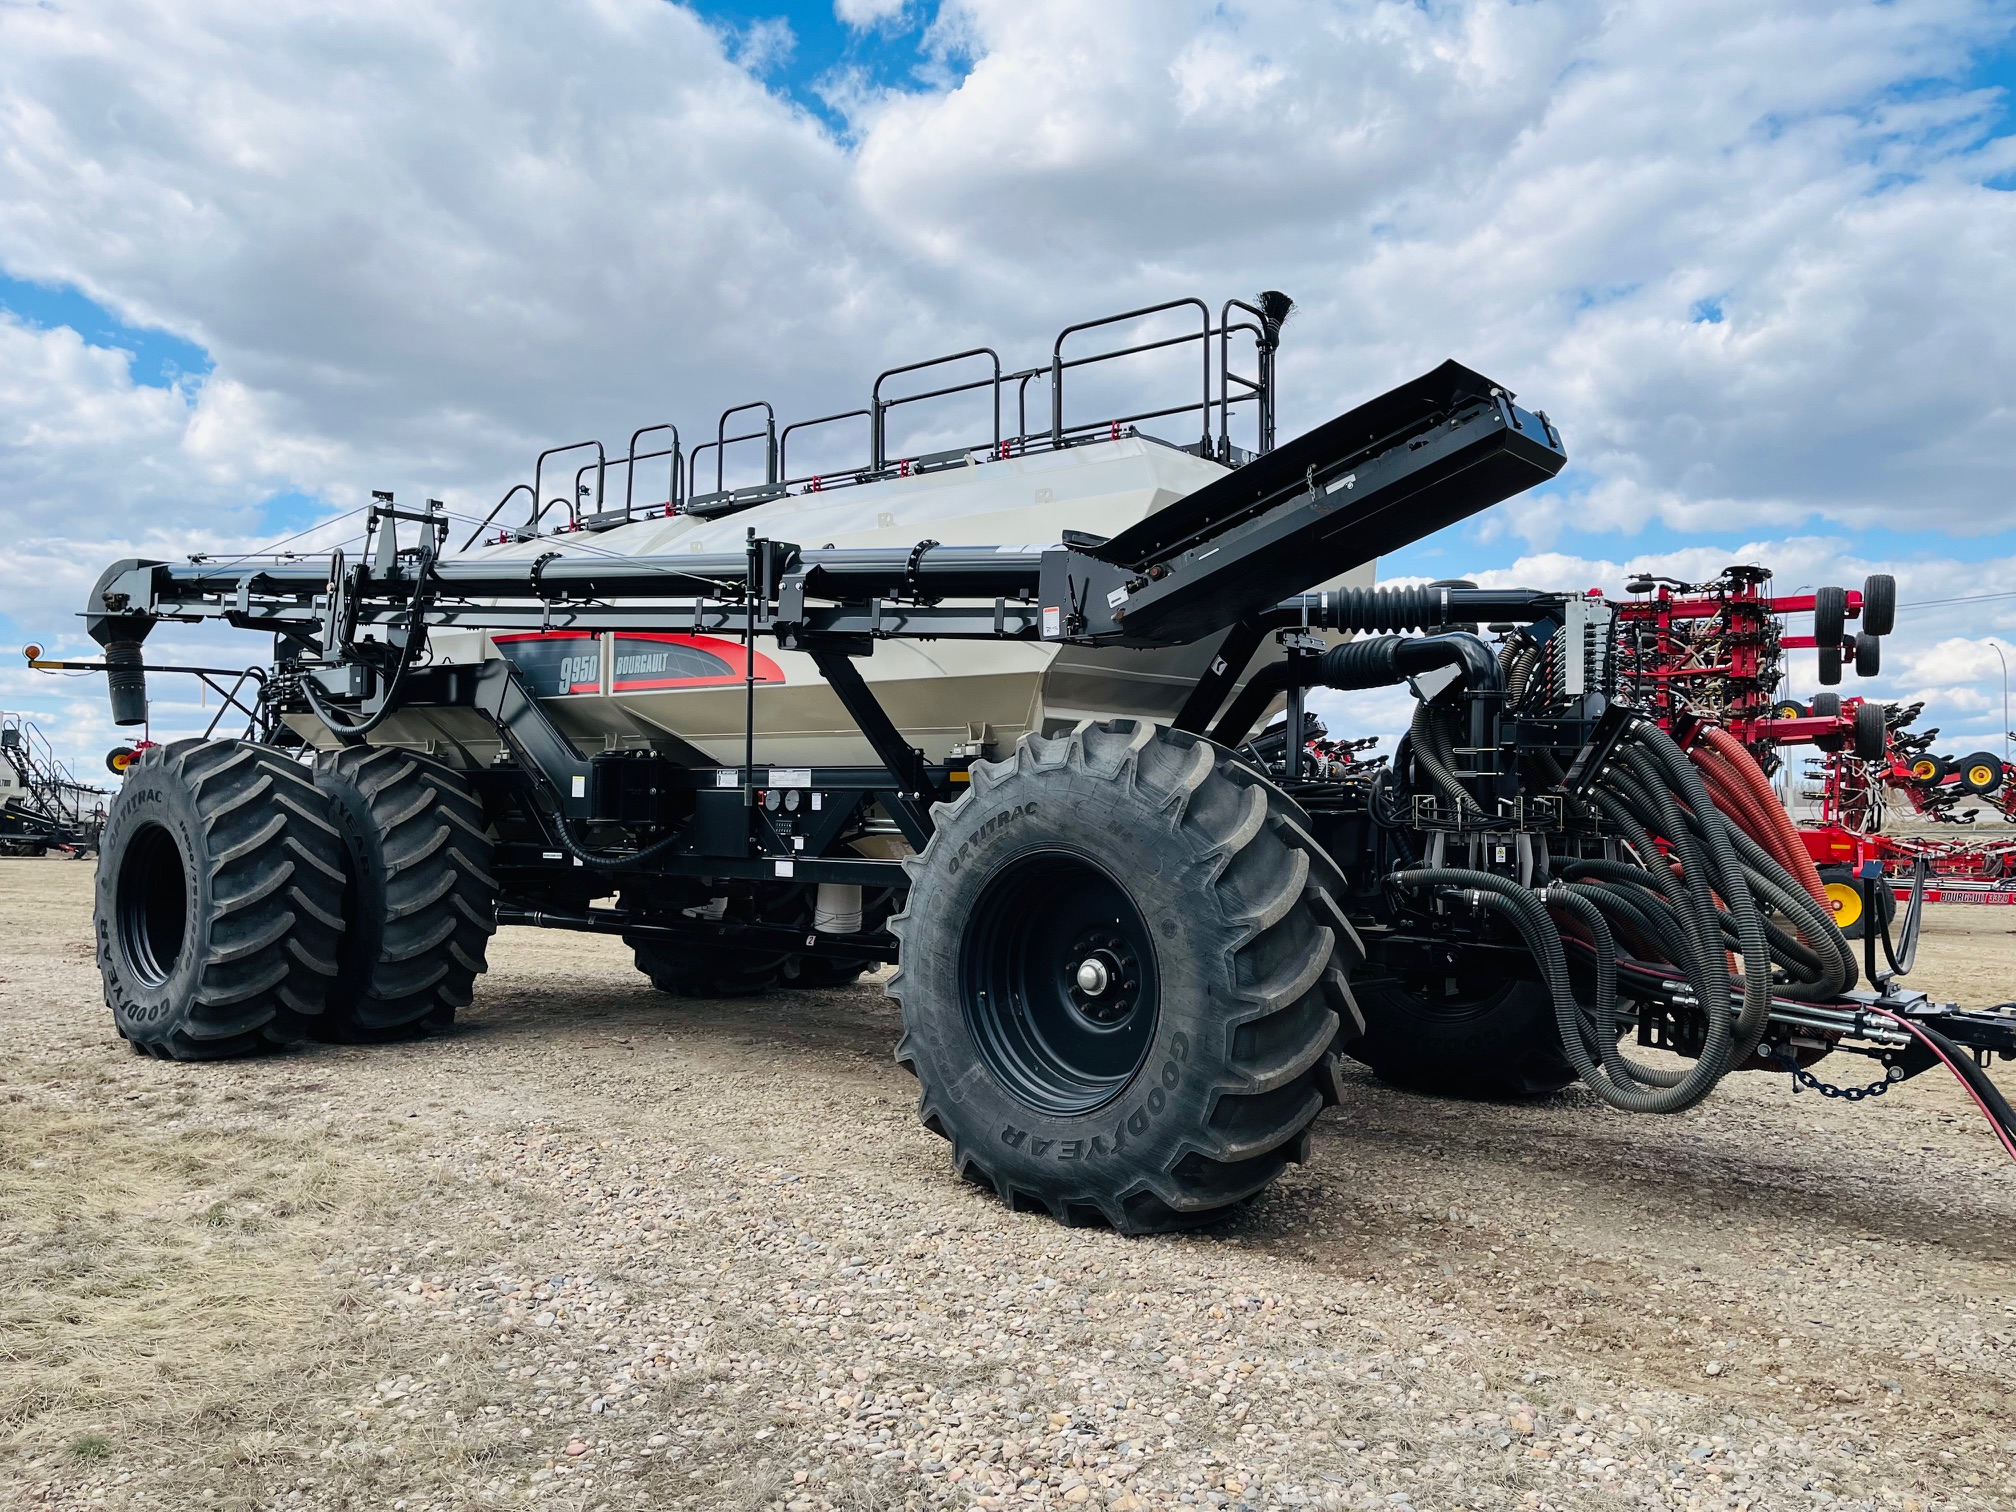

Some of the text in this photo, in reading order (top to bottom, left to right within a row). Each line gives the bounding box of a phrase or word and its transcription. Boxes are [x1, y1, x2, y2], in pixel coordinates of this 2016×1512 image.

[558, 655, 598, 695] 9950
[616, 653, 669, 675] BOURGAULT
[109, 788, 163, 851] OPTITRAC
[948, 801, 1038, 875] OPTITRAC
[1941, 892, 1987, 903] BOURGAULT
[101, 918, 170, 1022] GOODYEAR
[1001, 1031, 1190, 1162] GOODYEAR
